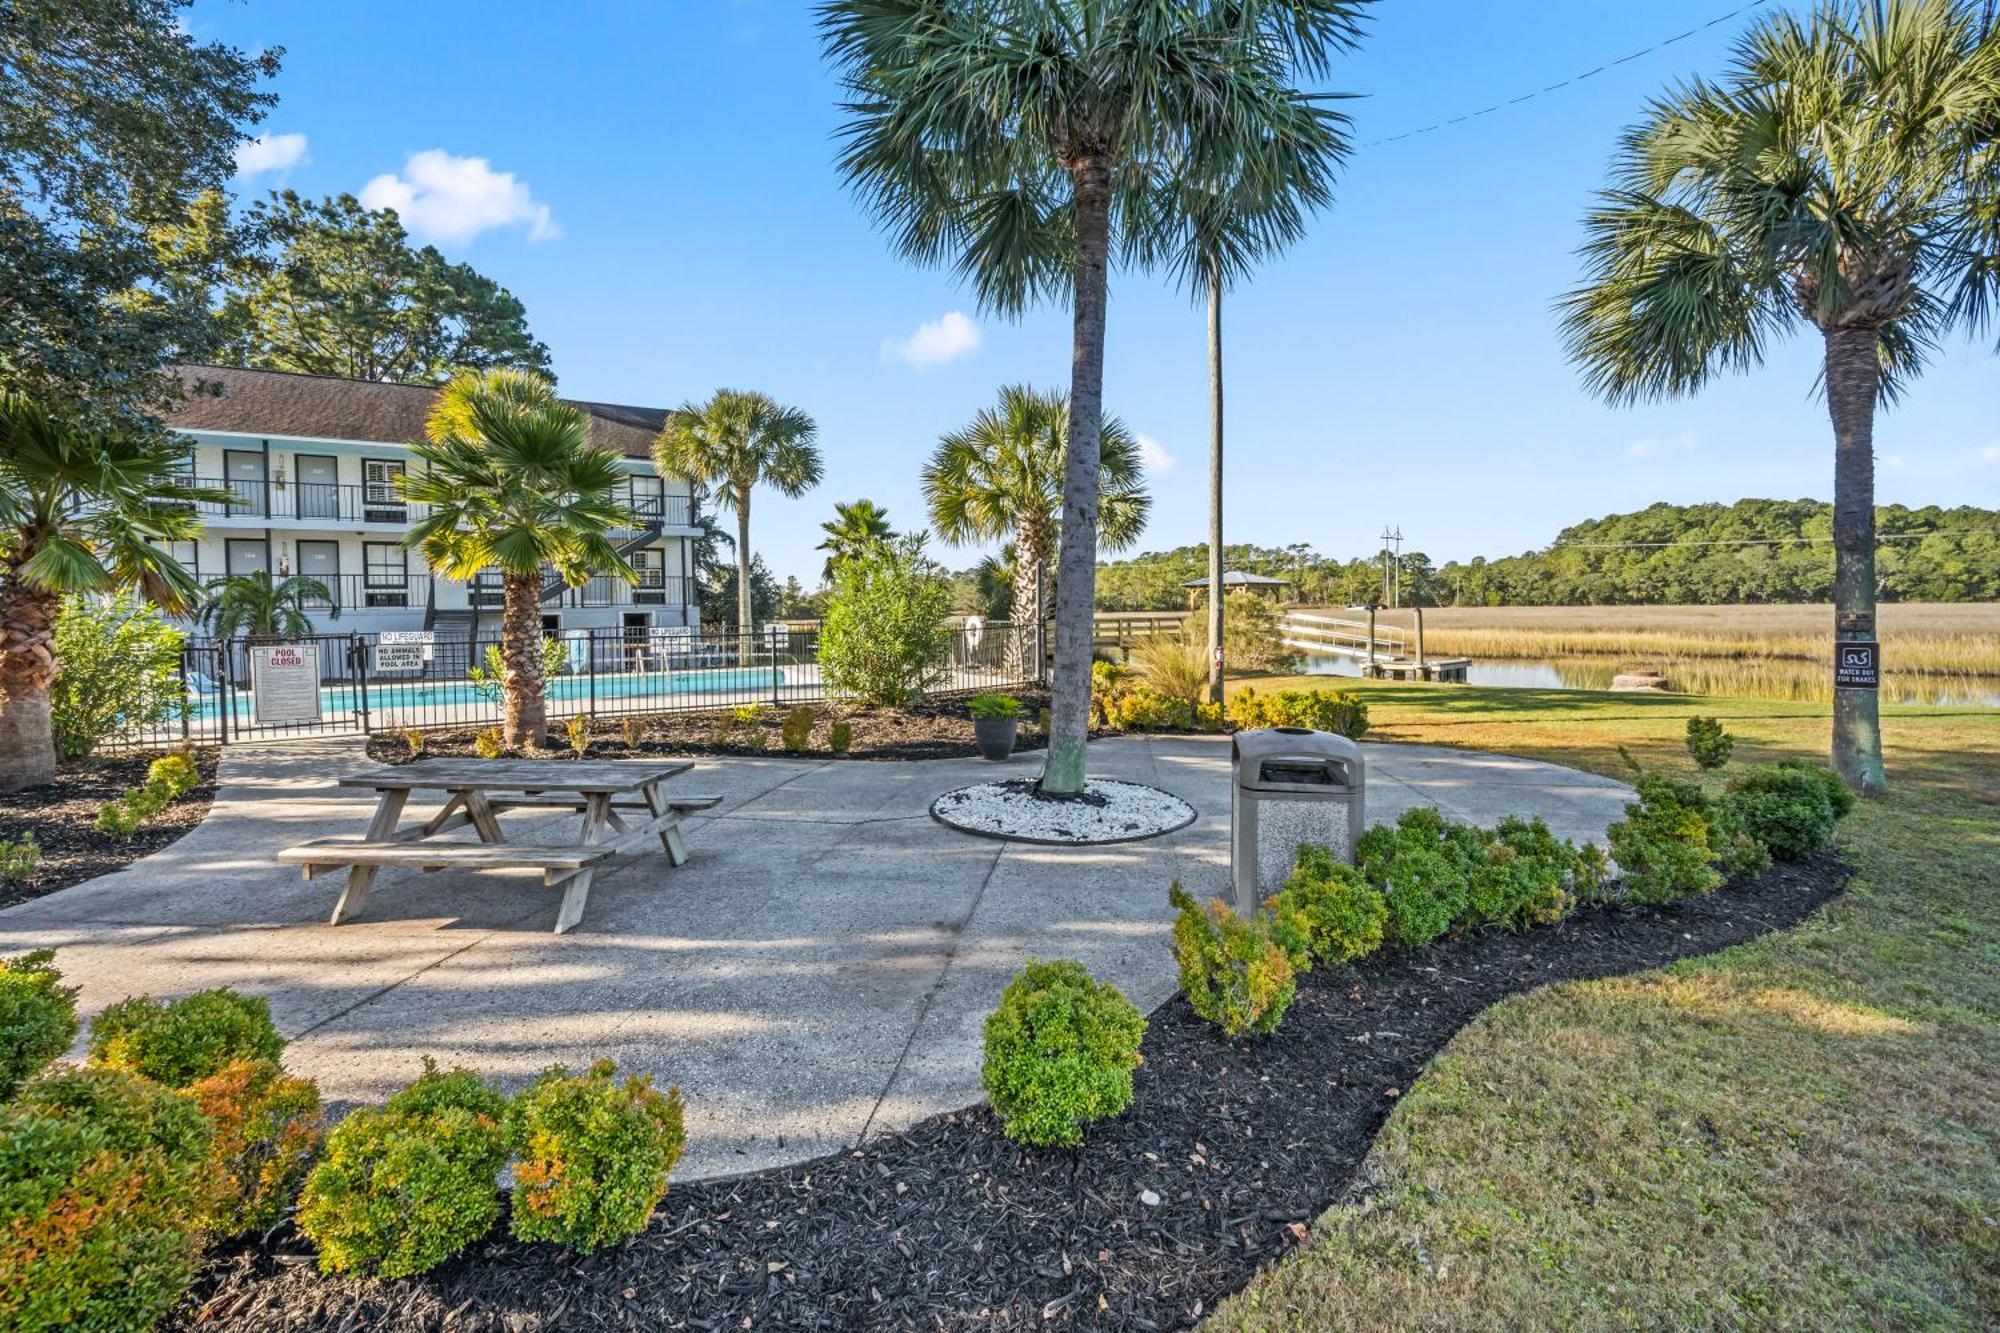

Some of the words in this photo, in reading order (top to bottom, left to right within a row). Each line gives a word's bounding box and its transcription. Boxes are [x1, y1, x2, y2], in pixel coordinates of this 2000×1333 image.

[382, 632, 393, 641] NO
[394, 632, 433, 641] LIFEGUARD
[275, 648, 296, 657] POOL
[271, 657, 301, 666] CLOSED
